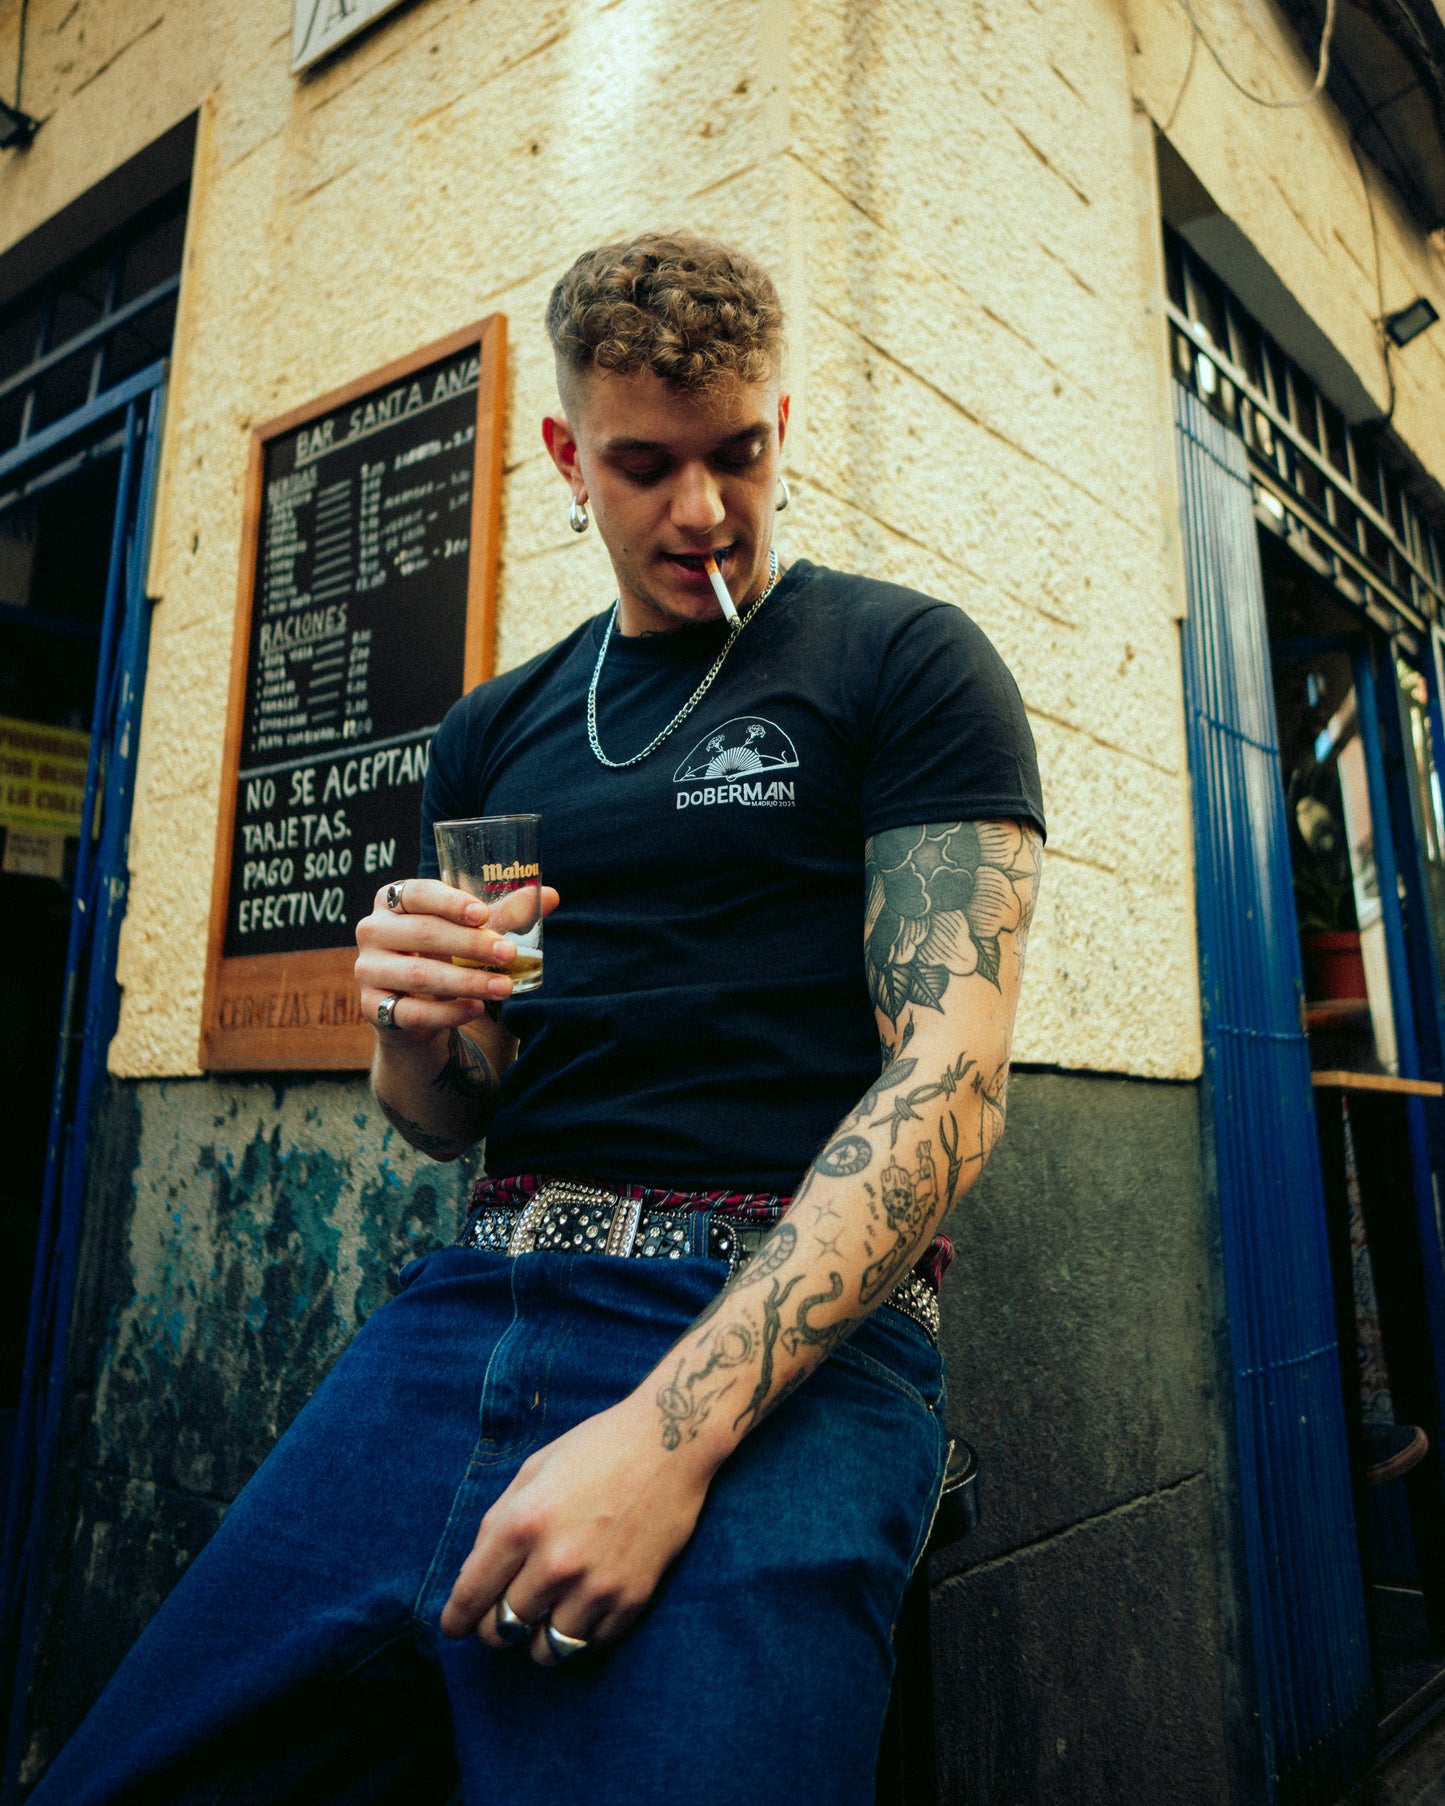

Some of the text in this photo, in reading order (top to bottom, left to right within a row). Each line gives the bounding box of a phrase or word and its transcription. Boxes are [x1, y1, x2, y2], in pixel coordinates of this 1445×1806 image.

[296, 358, 481, 461] BAR SANTA ANA
[260, 602, 349, 655] RACIONES
[246, 739, 431, 814] NO SE ACEPTAN
[676, 781, 795, 810] DOBERMAN
[751, 800, 778, 808] MADRID
[242, 809, 352, 854] TARJETAS.
[242, 838, 396, 892] PAGO SOLO EN
[481, 860, 539, 882] Mahou
[239, 886, 347, 933] EFECTIVO.
